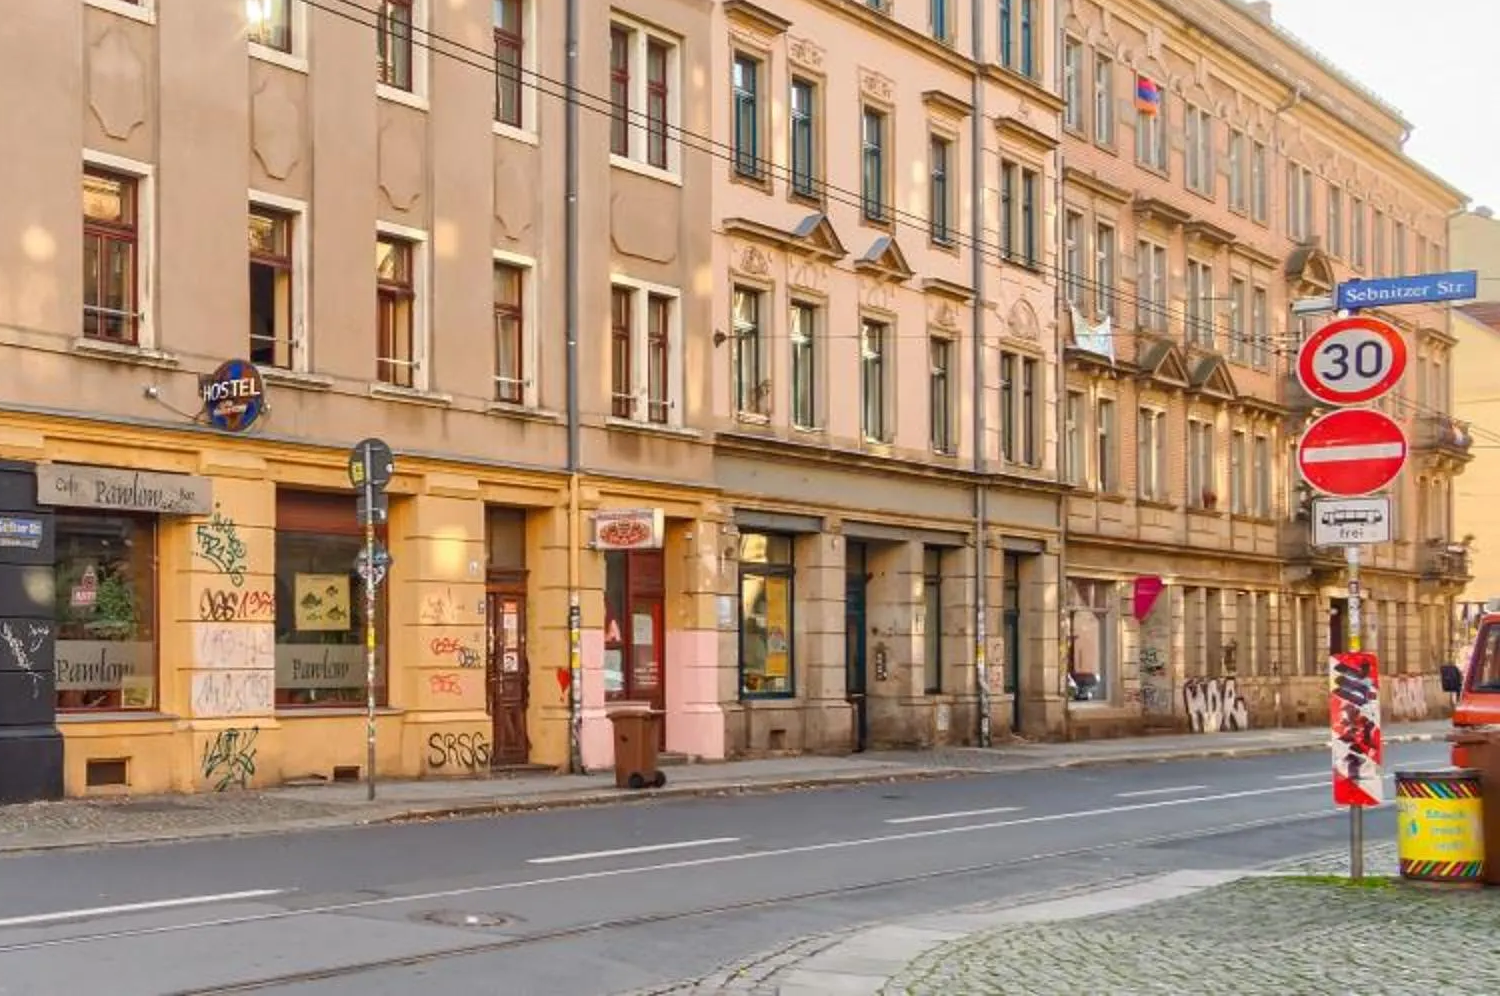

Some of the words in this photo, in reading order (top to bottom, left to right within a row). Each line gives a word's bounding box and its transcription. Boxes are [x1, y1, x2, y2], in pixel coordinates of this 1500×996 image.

[1345, 284, 1431, 302] Sebnitzer
[1436, 279, 1468, 295] Str.
[1320, 339, 1384, 382] 30
[203, 377, 261, 403] HOSTEL
[1339, 527, 1365, 539] frei
